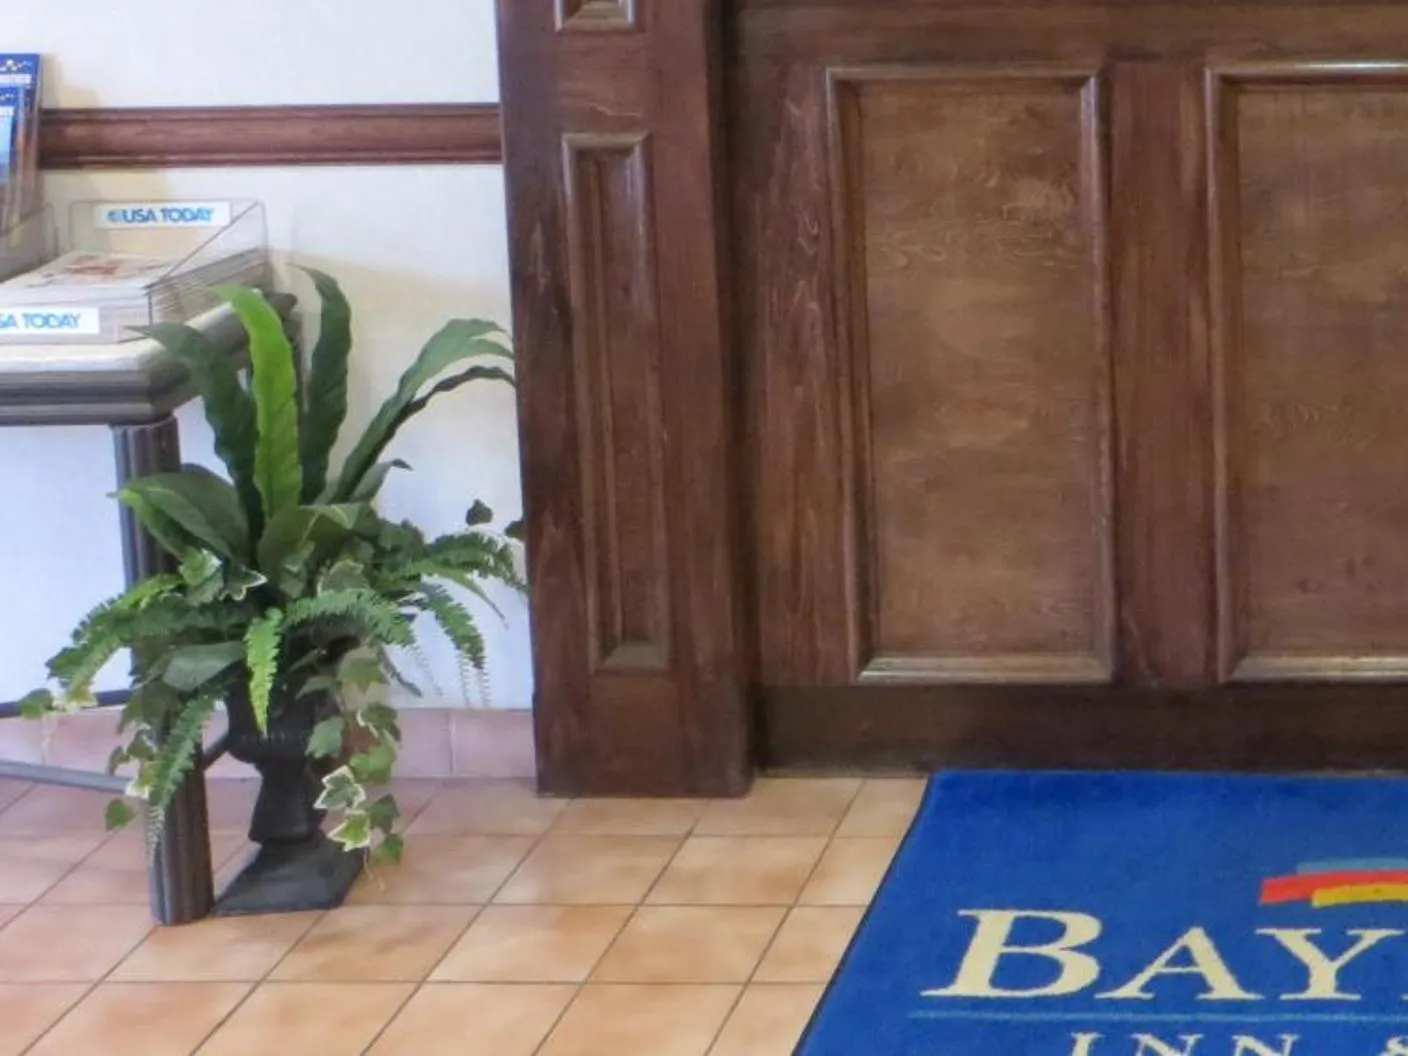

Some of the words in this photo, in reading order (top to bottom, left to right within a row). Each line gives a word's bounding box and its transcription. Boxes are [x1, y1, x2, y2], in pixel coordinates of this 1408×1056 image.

[122, 208, 157, 223] USA
[160, 207, 214, 223] TODAY
[21, 312, 82, 329] TODAY
[1070, 1032, 1301, 1056] INN
